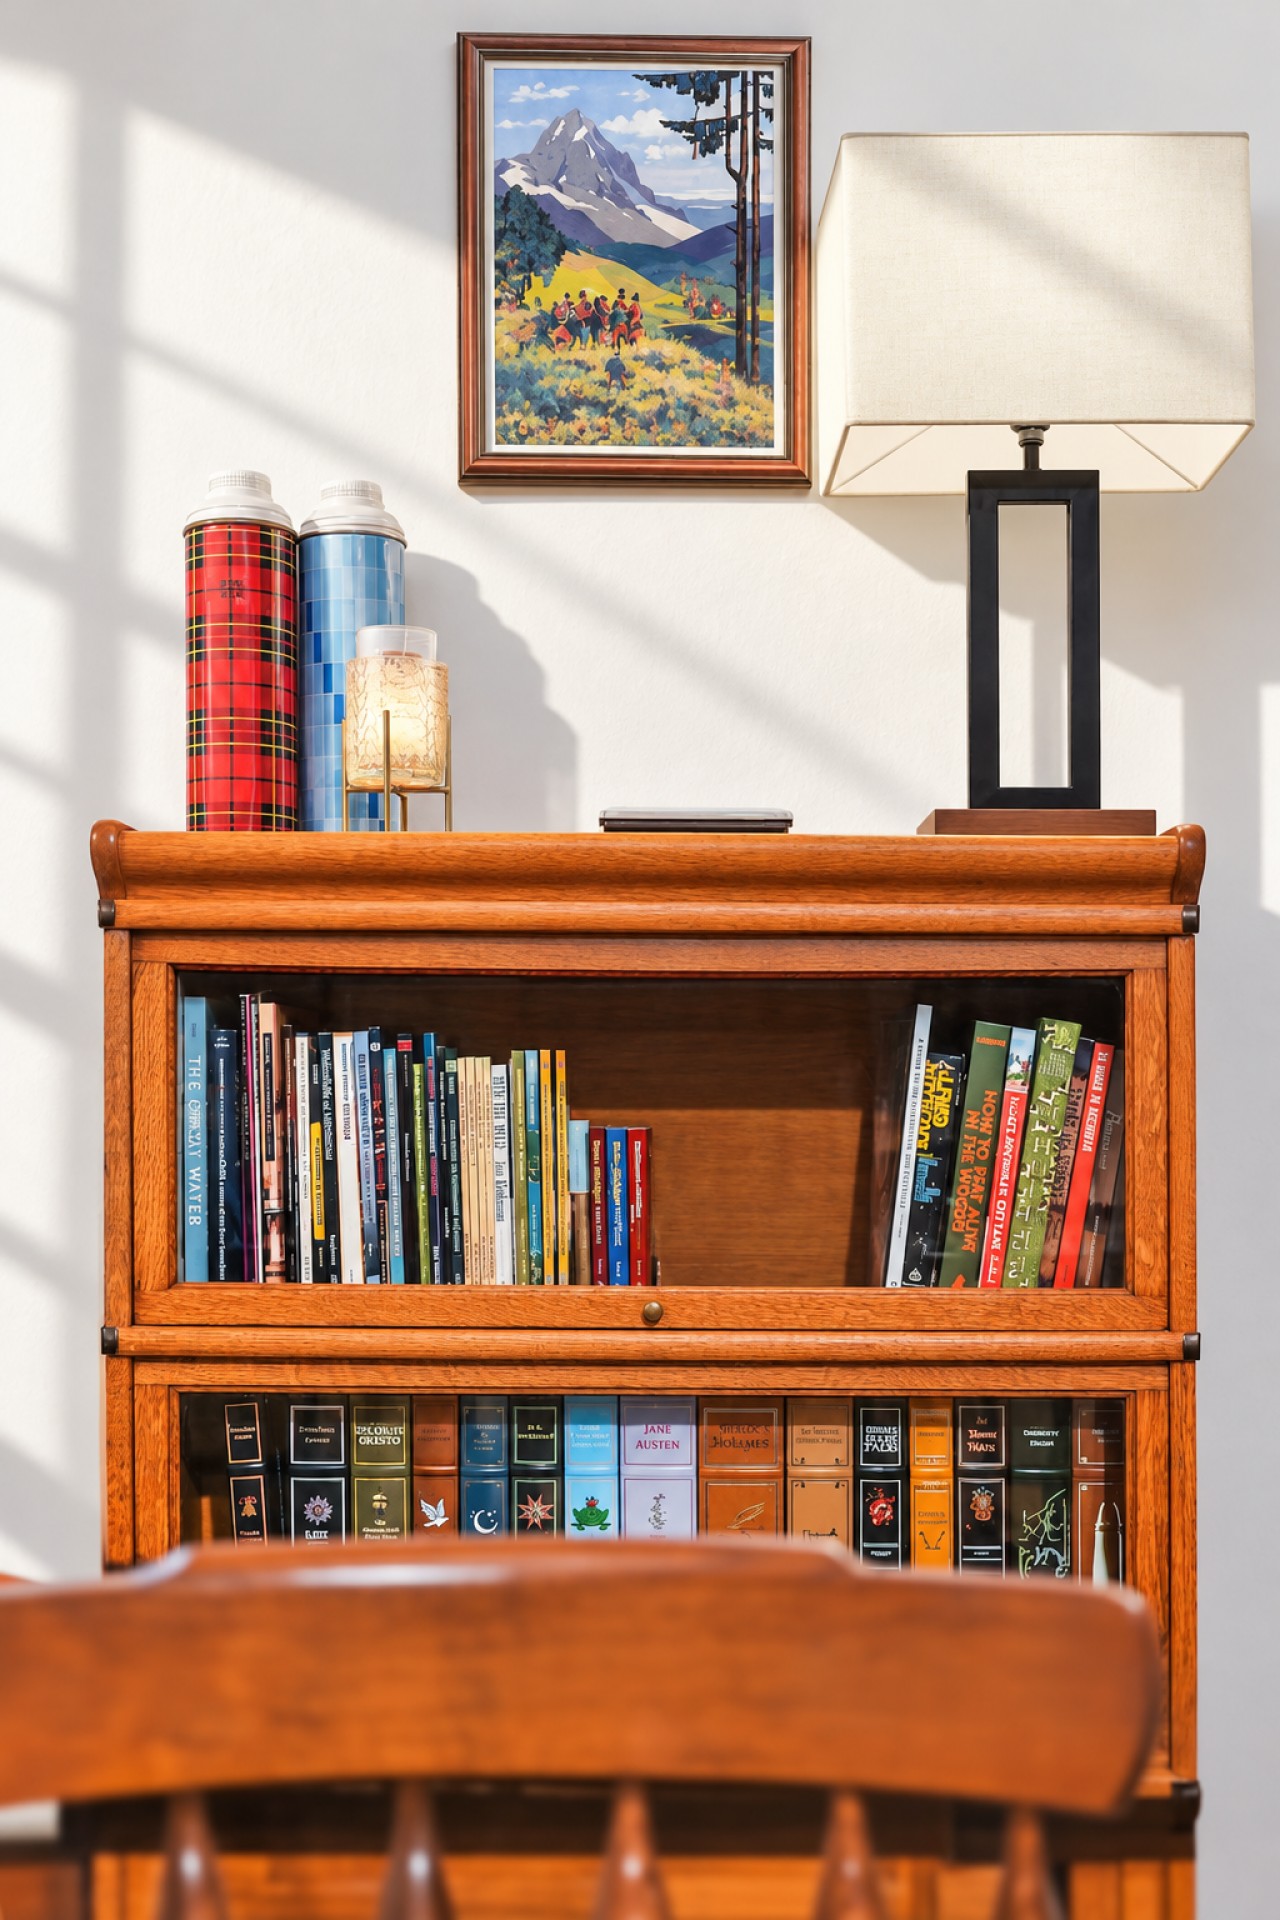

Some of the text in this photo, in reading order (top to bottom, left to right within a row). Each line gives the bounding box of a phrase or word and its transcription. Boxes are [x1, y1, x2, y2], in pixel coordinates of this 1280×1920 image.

[188, 1055, 201, 1090] THE
[644, 1424, 671, 1435] JANE
[635, 1440, 680, 1450] AUSTEN
